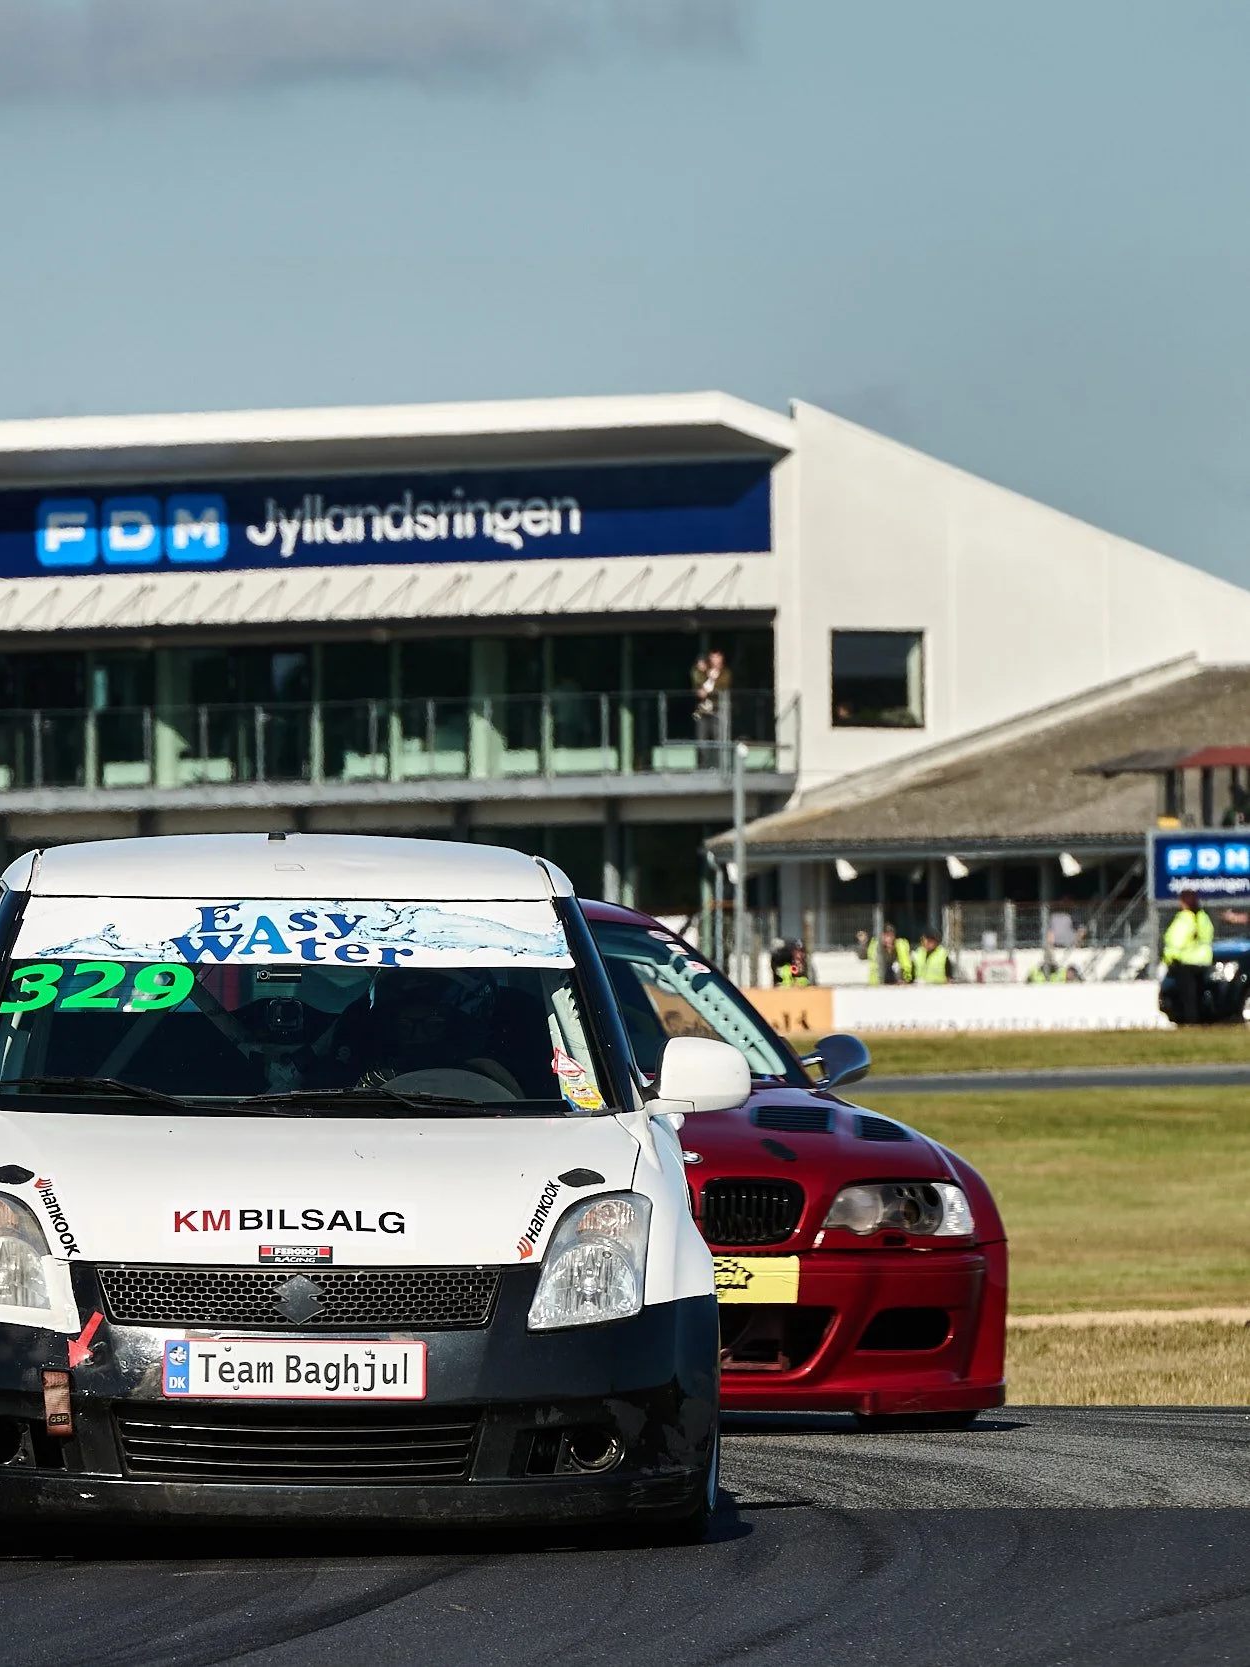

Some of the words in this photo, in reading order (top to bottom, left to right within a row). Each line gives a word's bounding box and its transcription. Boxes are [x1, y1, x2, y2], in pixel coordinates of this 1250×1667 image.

[44, 508, 221, 552] FDM
[246, 489, 582, 558] Jyllandsringen
[274, 1247, 318, 1256] FERODO
[274, 1256, 316, 1264] RACING
[197, 1353, 274, 1384] Team
[285, 1353, 409, 1392] Baghjul
[168, 1376, 186, 1389] DK
